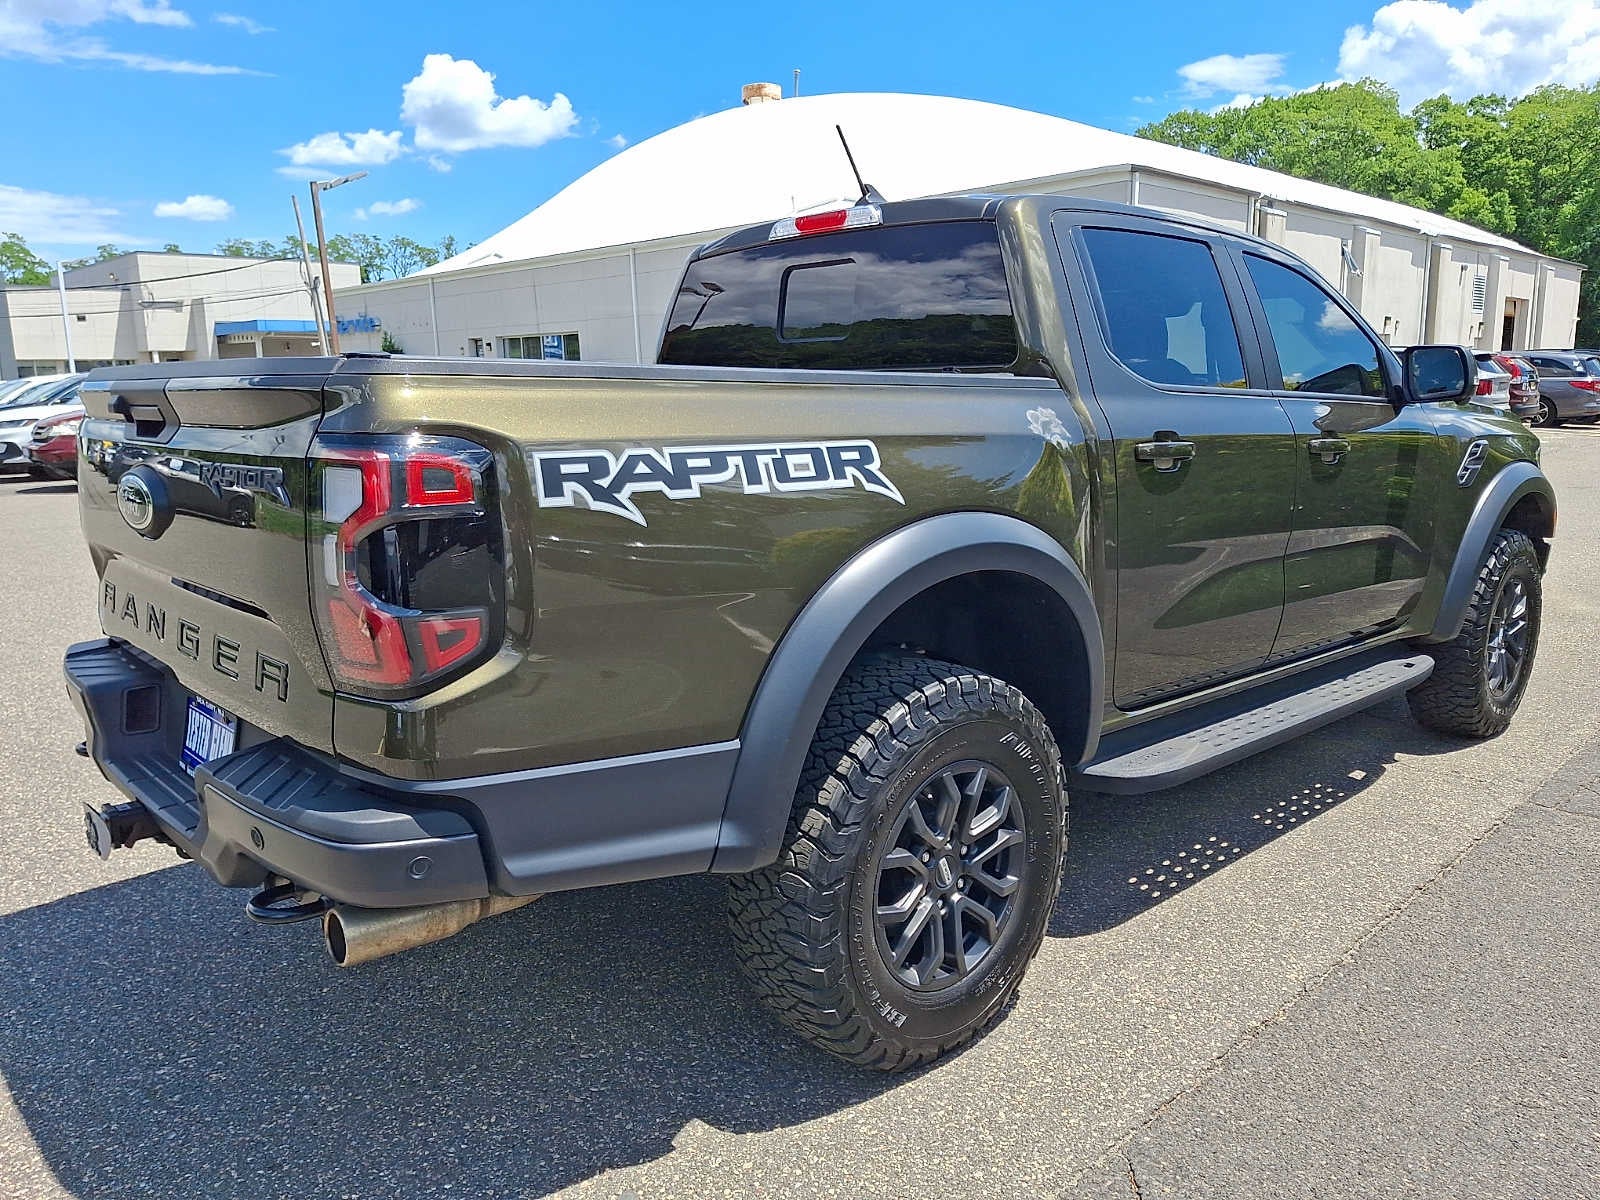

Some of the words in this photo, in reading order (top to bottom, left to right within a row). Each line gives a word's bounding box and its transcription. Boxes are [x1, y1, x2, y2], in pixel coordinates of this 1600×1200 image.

[199, 461, 291, 509] RAPTOR
[532, 439, 906, 527] RAPTOR
[104, 580, 289, 703] RANGER
